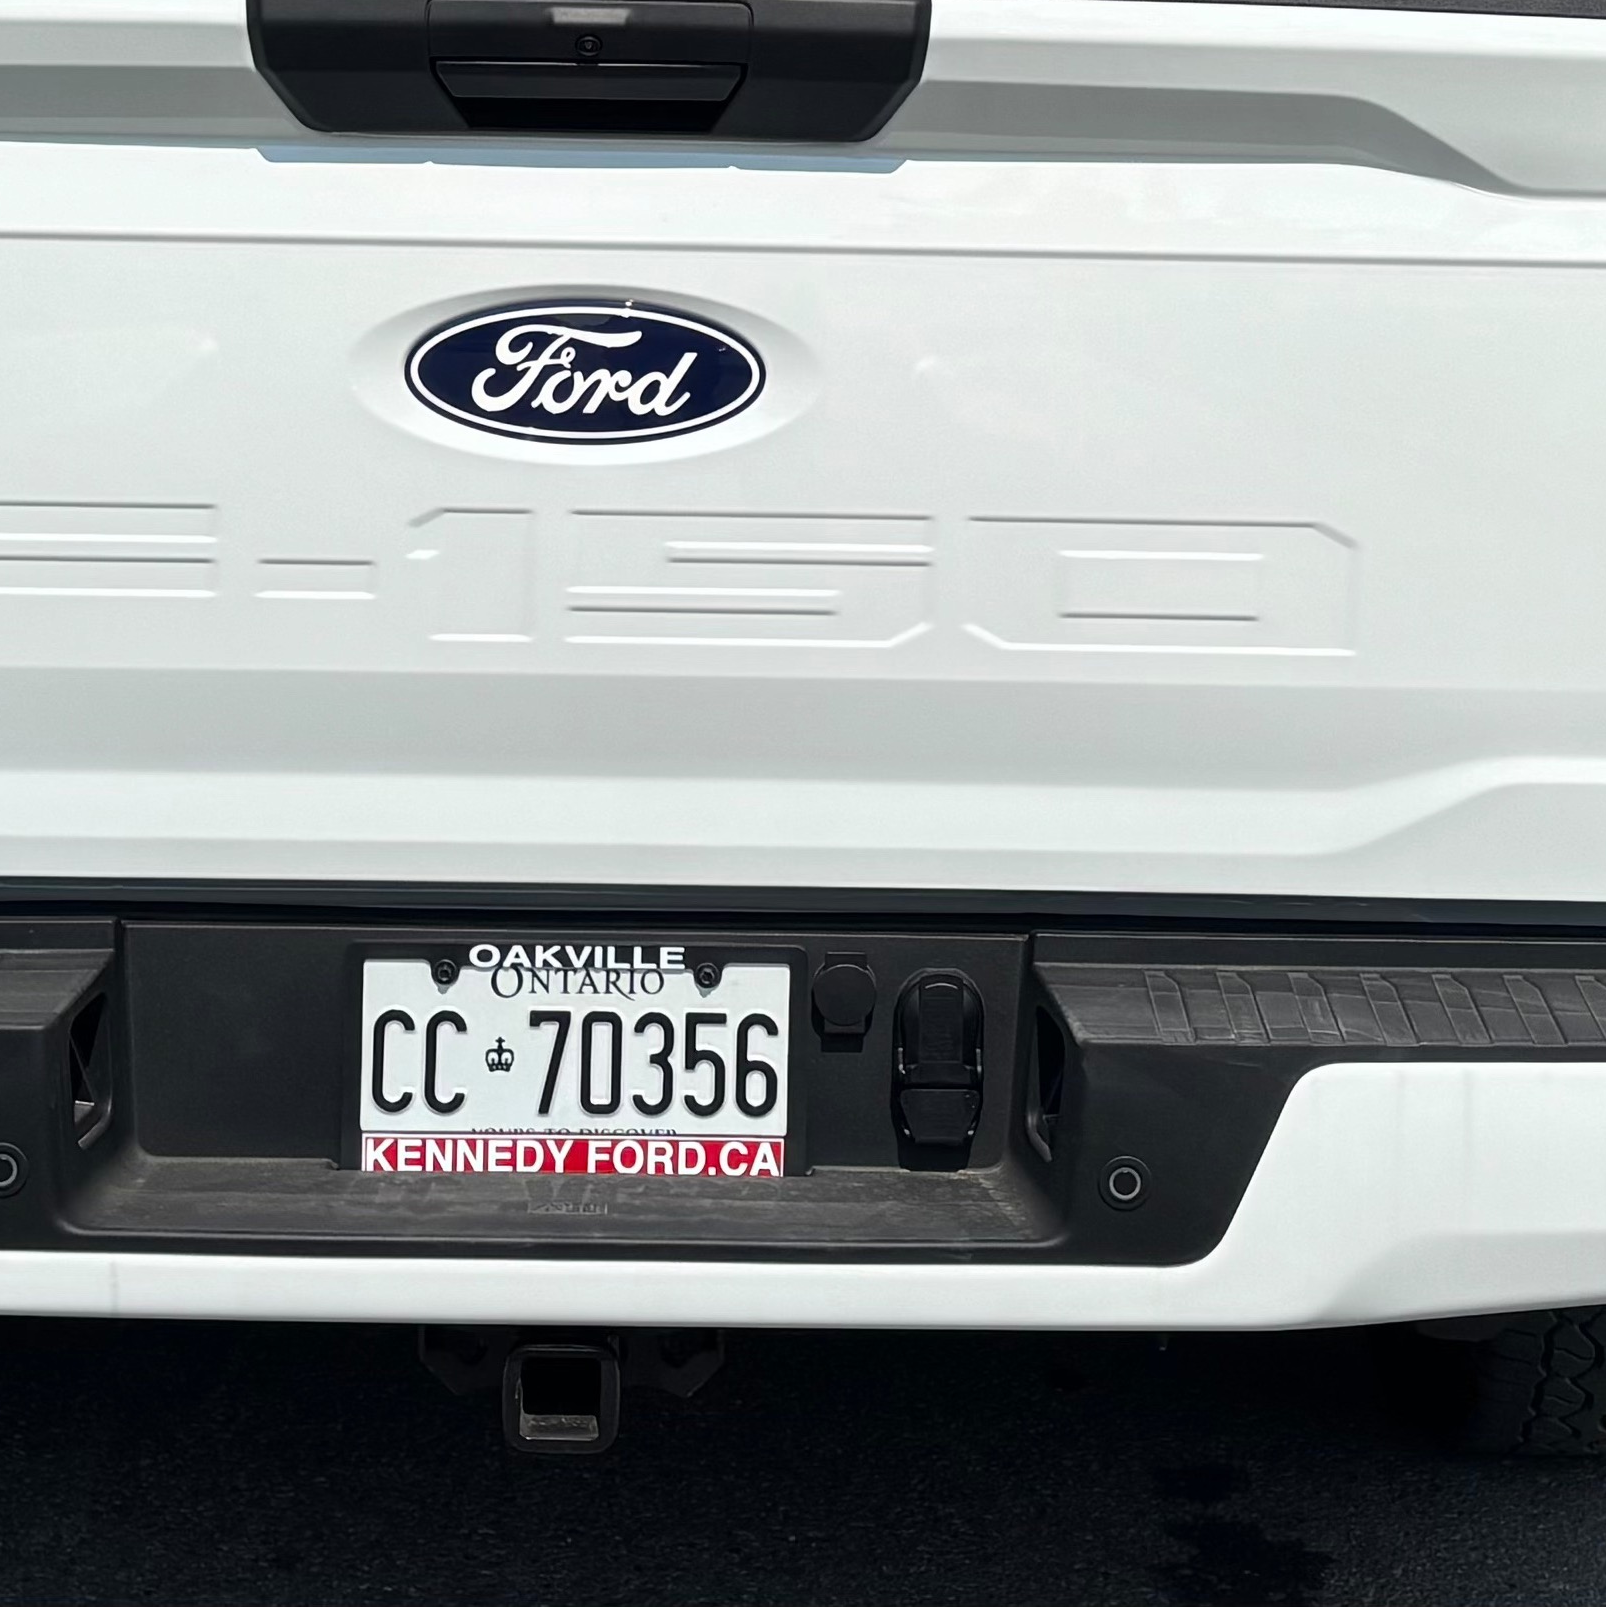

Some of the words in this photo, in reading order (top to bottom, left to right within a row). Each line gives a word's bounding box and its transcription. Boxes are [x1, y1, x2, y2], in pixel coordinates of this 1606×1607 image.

[471, 324, 698, 416] Ford
[469, 944, 685, 970] OAKVILLE
[491, 966, 665, 1001] ONTARIO
[372, 1009, 467, 1113] CC
[529, 1010, 779, 1117] 70356
[366, 1138, 574, 1173] KENNEDY
[587, 1140, 780, 1176] FORD.CA
